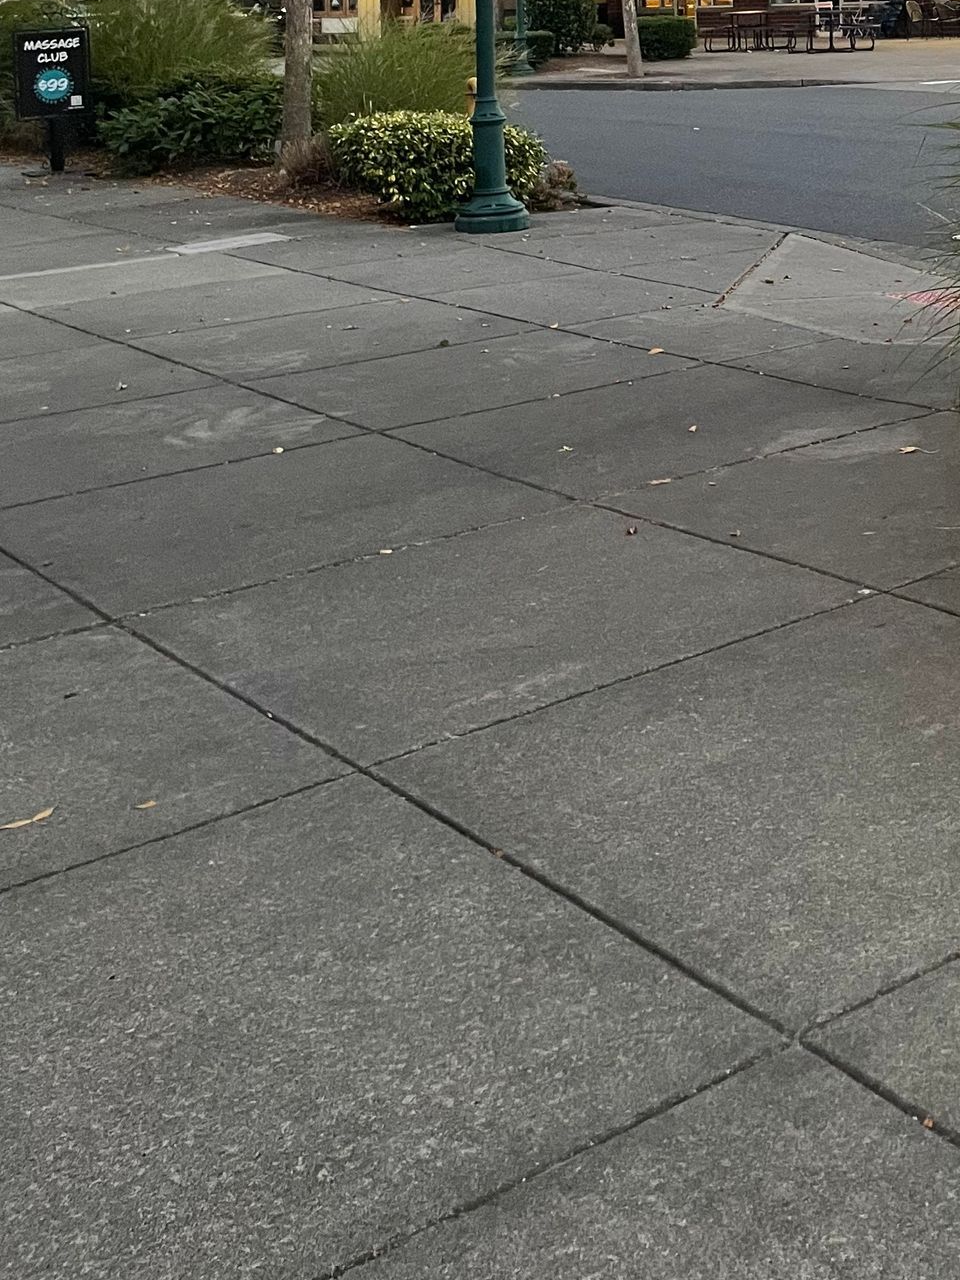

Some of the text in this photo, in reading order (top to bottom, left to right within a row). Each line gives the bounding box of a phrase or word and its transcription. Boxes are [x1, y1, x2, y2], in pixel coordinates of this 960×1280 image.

[24, 37, 80, 51] MASSAGE
[37, 51, 68, 63] CLUB
[38, 78, 68, 91] $99
